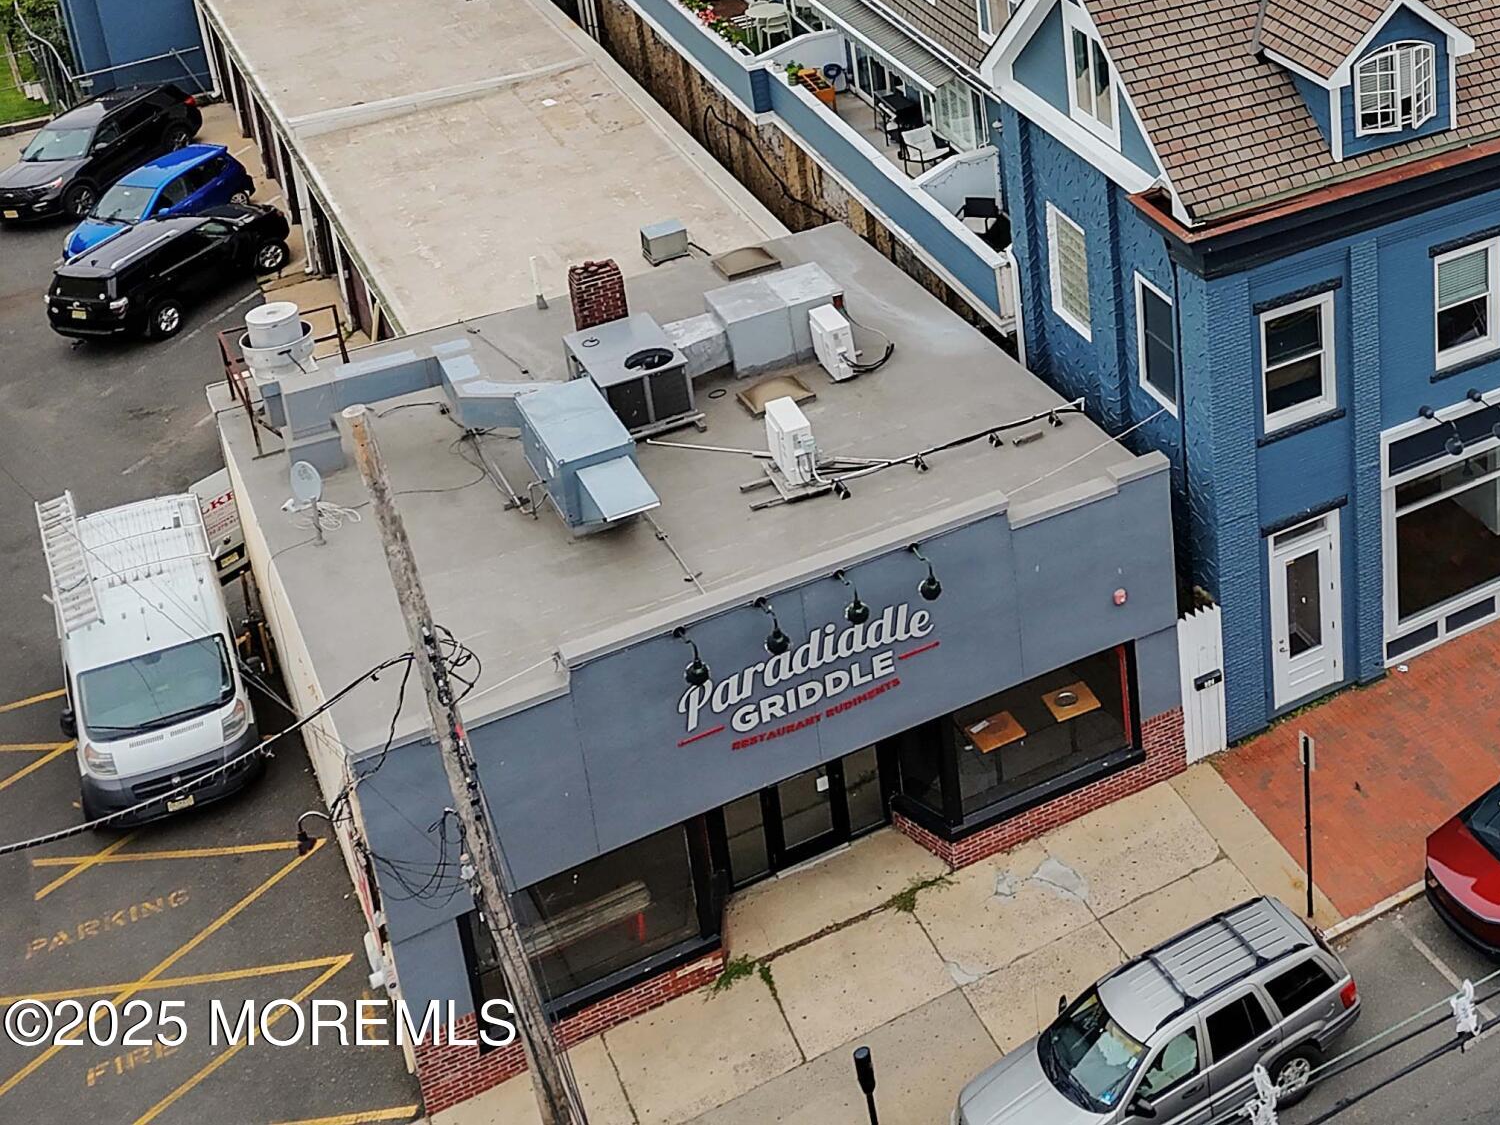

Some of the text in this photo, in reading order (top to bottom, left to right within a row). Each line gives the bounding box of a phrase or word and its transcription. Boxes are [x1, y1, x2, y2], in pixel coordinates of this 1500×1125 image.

[730, 650, 896, 733] GRIDDLE
[731, 678, 901, 752] RESTAURANT RUDIMENTS
[25, 888, 191, 960] PARKING
[86, 1034, 180, 1087] FIRE
